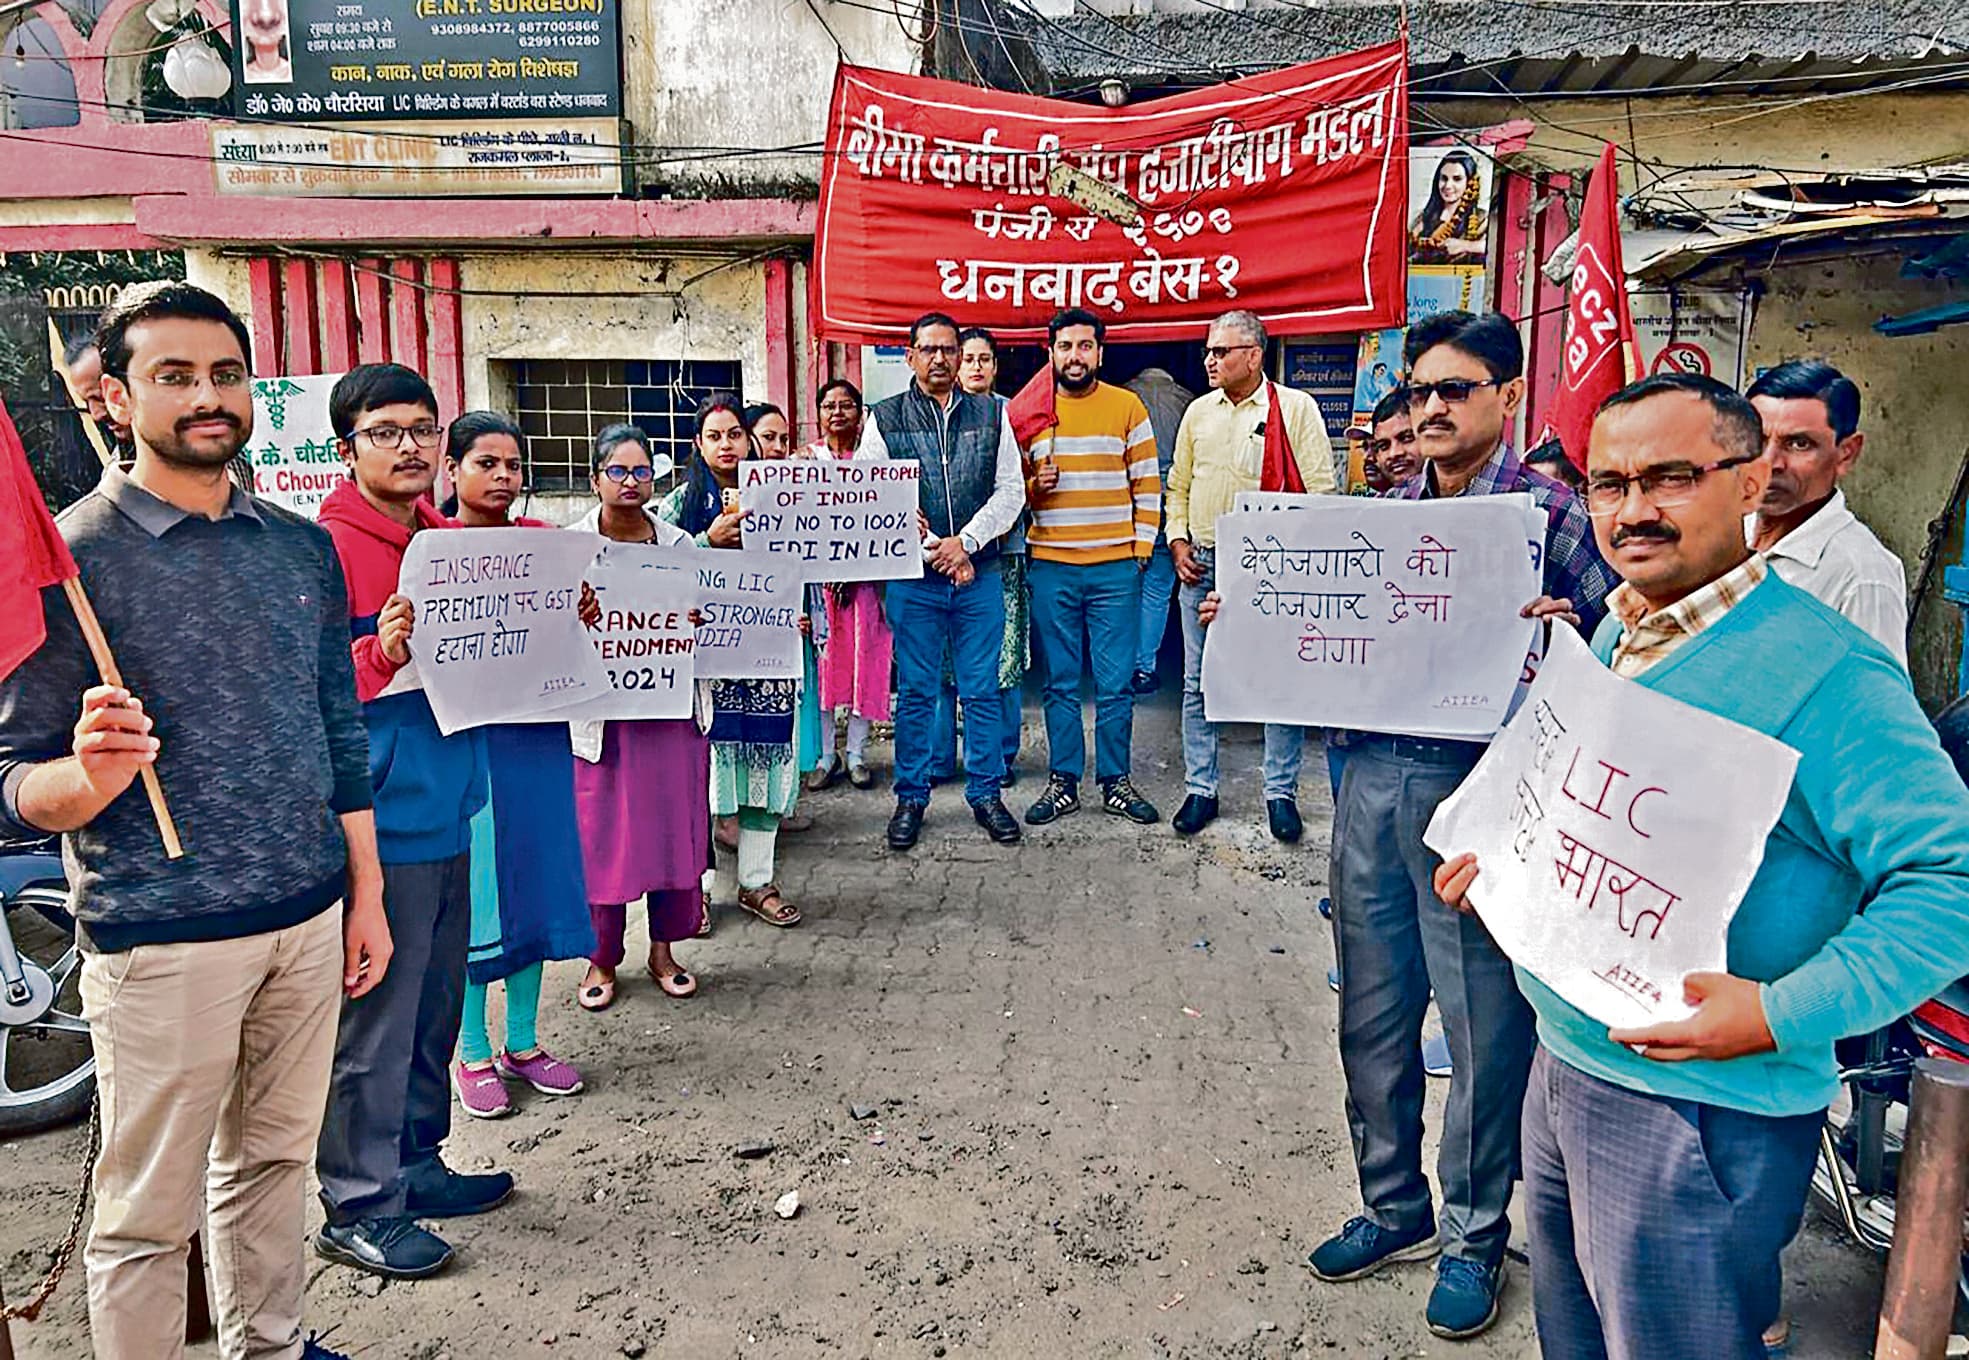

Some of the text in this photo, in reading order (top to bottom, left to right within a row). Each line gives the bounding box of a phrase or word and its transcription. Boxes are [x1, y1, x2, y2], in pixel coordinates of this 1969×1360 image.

[489, 0, 604, 14] SURGEON)
[331, 65, 371, 82] कान,
[375, 64, 417, 82] नाक,
[422, 59, 447, 81] एवं
[449, 64, 483, 80] गला
[488, 58, 517, 78] रोग
[324, 92, 385, 113] चौरसिया
[393, 95, 411, 111] LIC
[221, 138, 257, 161] संध्या
[330, 137, 367, 161] ENT
[847, 104, 926, 185] बीमा
[928, 128, 1060, 197] कर्मचारी
[1138, 117, 1297, 201] हजारीबाग
[972, 203, 1057, 240] पंजी
[276, 470, 346, 492] Choura
[747, 466, 922, 487] APPEAL TO PEOPLE
[776, 489, 878, 507] OF INDIA
[744, 511, 908, 533] SAY NO TO 100%
[829, 541, 860, 561] IN
[868, 538, 907, 558] LIC
[1406, 535, 1457, 579] को
[428, 553, 534, 586] INSURANCE
[737, 573, 775, 593] LIC
[423, 588, 574, 625] PREMIUM पर GST
[1251, 580, 1368, 621] रोजगार
[703, 602, 795, 629] STRONGER
[1297, 622, 1375, 665] होगा
[1561, 746, 1668, 839] LIC
[1555, 829, 1682, 940] भारत
